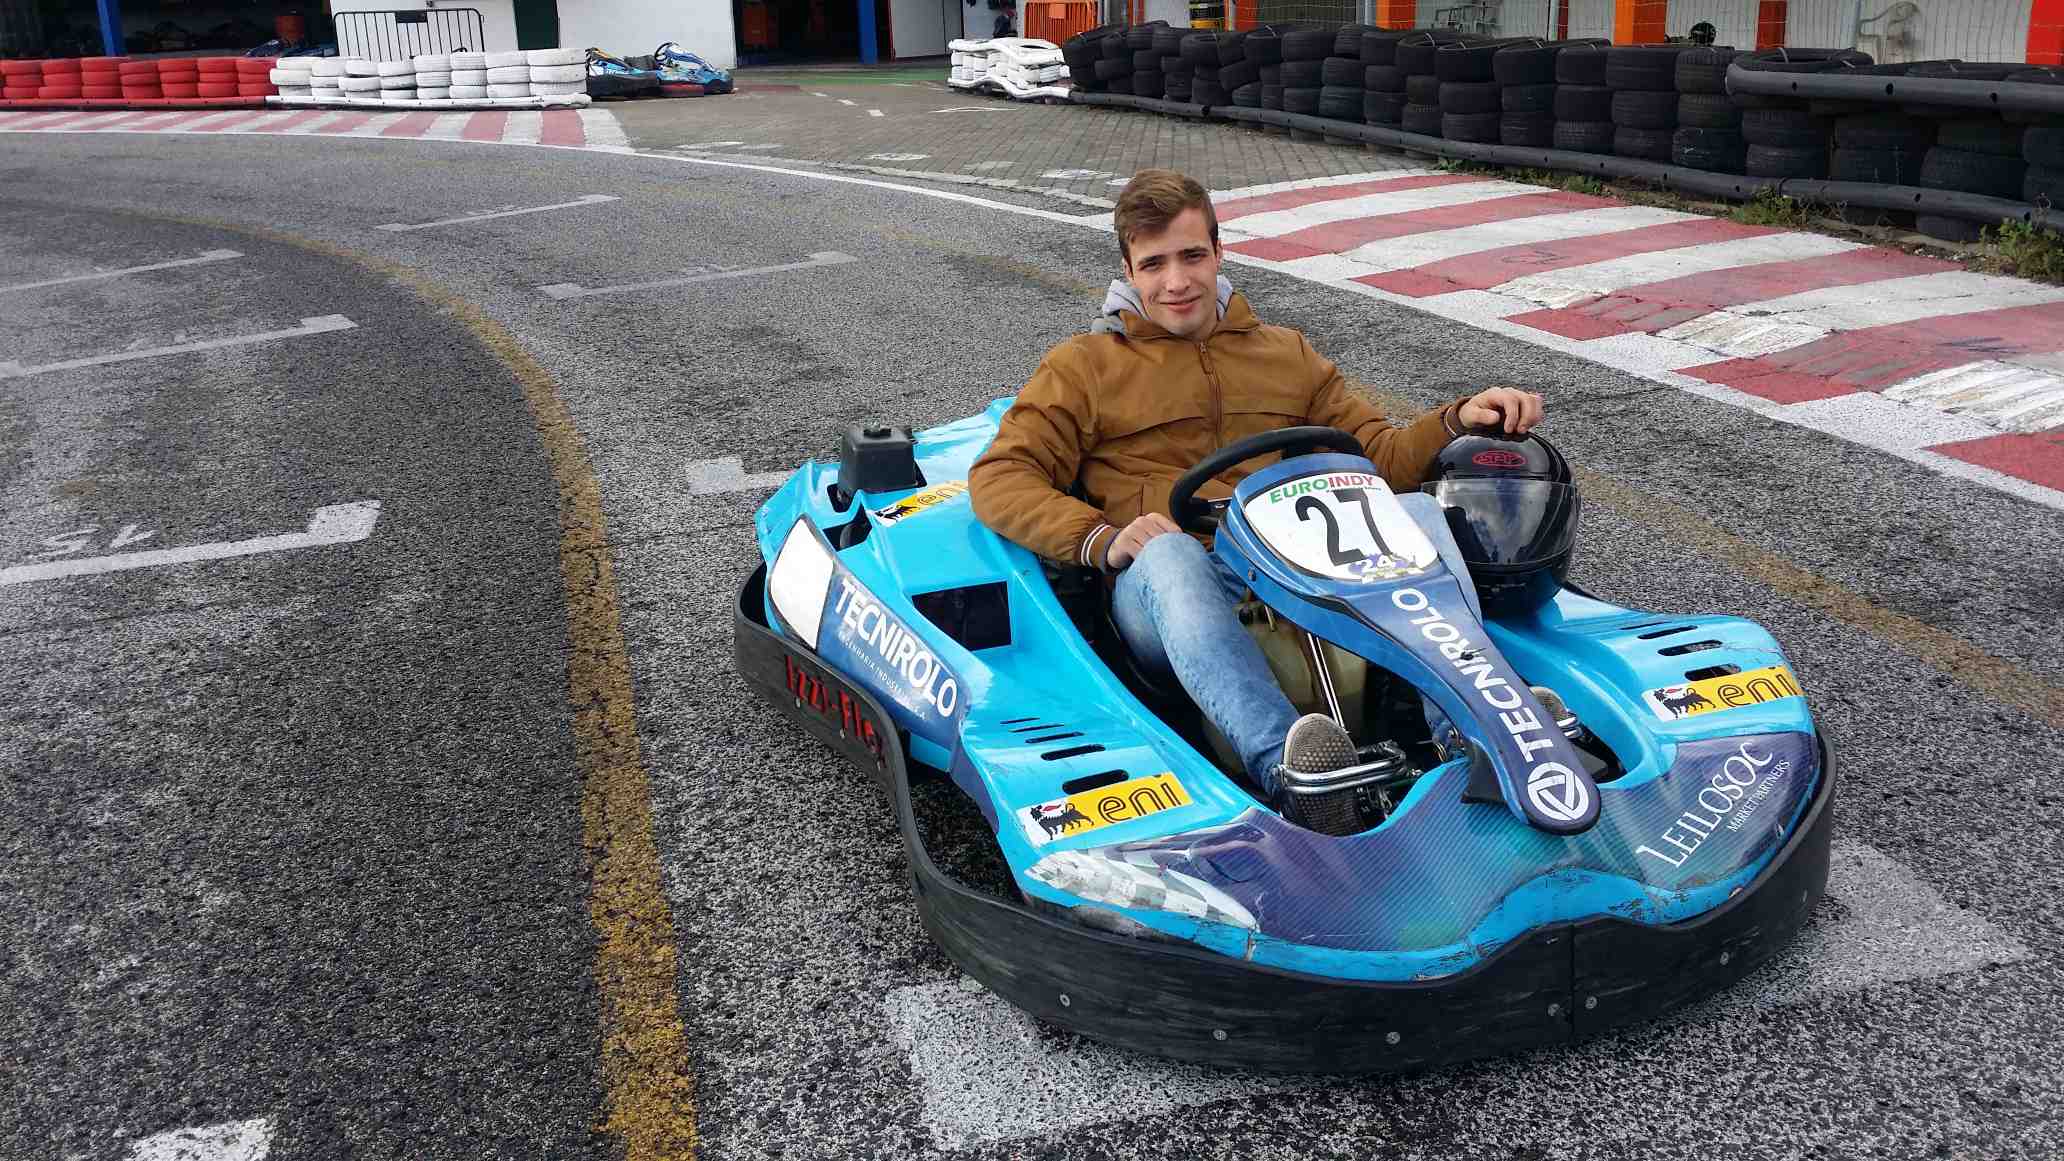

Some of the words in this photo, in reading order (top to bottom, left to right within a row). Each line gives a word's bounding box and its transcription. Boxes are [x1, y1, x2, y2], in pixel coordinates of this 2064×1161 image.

[1270, 475, 1375, 504] EUROINDY
[1295, 487, 1393, 566] 27
[834, 578, 958, 717] TECNIROLO
[1392, 587, 1554, 762] TECNIROLO
[1718, 666, 1799, 709] eni
[1098, 774, 1182, 824] eni
[1636, 742, 1773, 868] LEILOSOC
